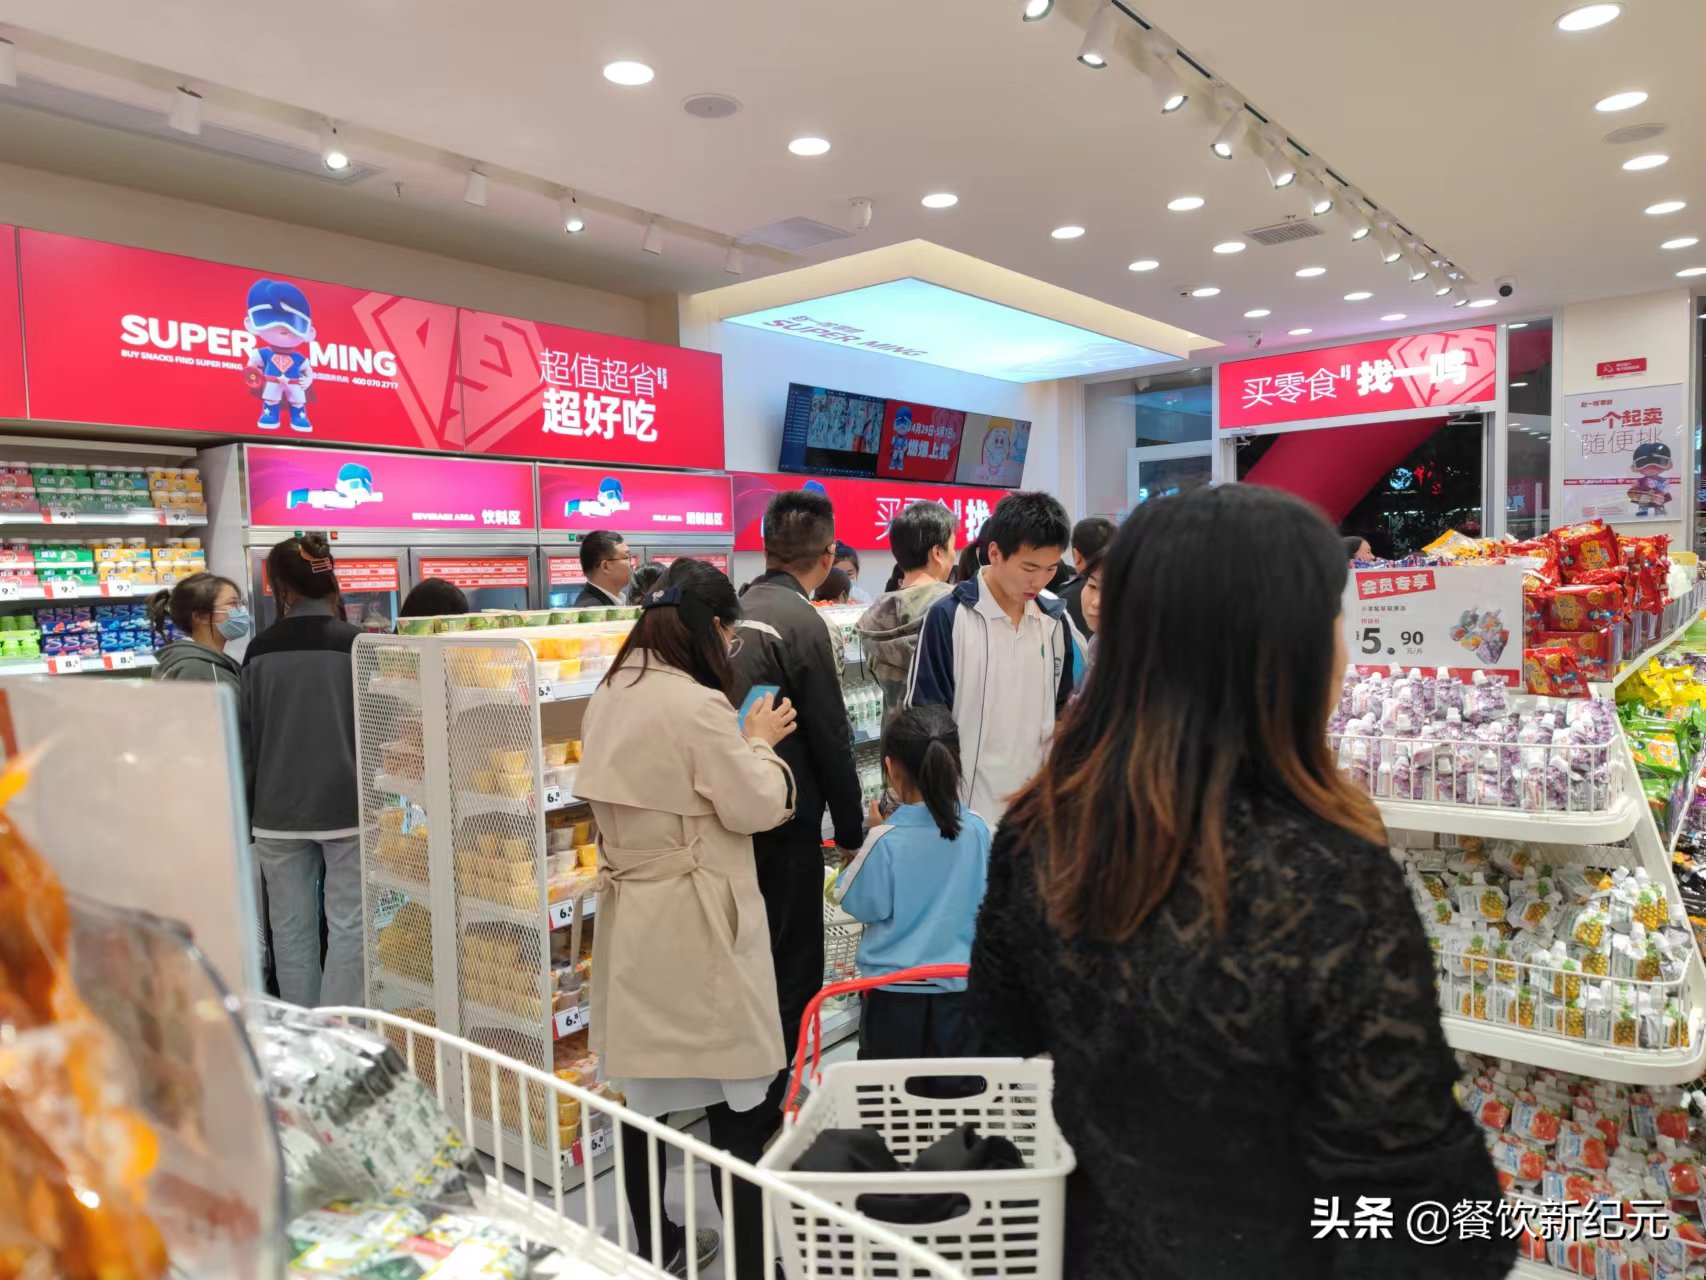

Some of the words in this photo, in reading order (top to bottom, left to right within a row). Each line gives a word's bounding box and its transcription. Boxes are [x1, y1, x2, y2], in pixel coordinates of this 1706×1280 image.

[120, 314, 257, 358] SUPER
[309, 340, 397, 377] MING
[762, 319, 862, 343] SUPER
[858, 340, 928, 357] MING
[120, 349, 139, 359] BUY
[140, 351, 174, 363] SNACKS
[174, 356, 194, 365] FIND
[195, 358, 221, 369] SUPER
[221, 361, 243, 371] MING
[539, 347, 657, 398] 超值超省
[1357, 350, 1467, 397] 找一鸣
[1241, 367, 1340, 409] 买零食
[542, 387, 658, 442] 超好吃
[1581, 407, 1664, 429] 一个起卖
[1361, 573, 1429, 595] 会员专享
